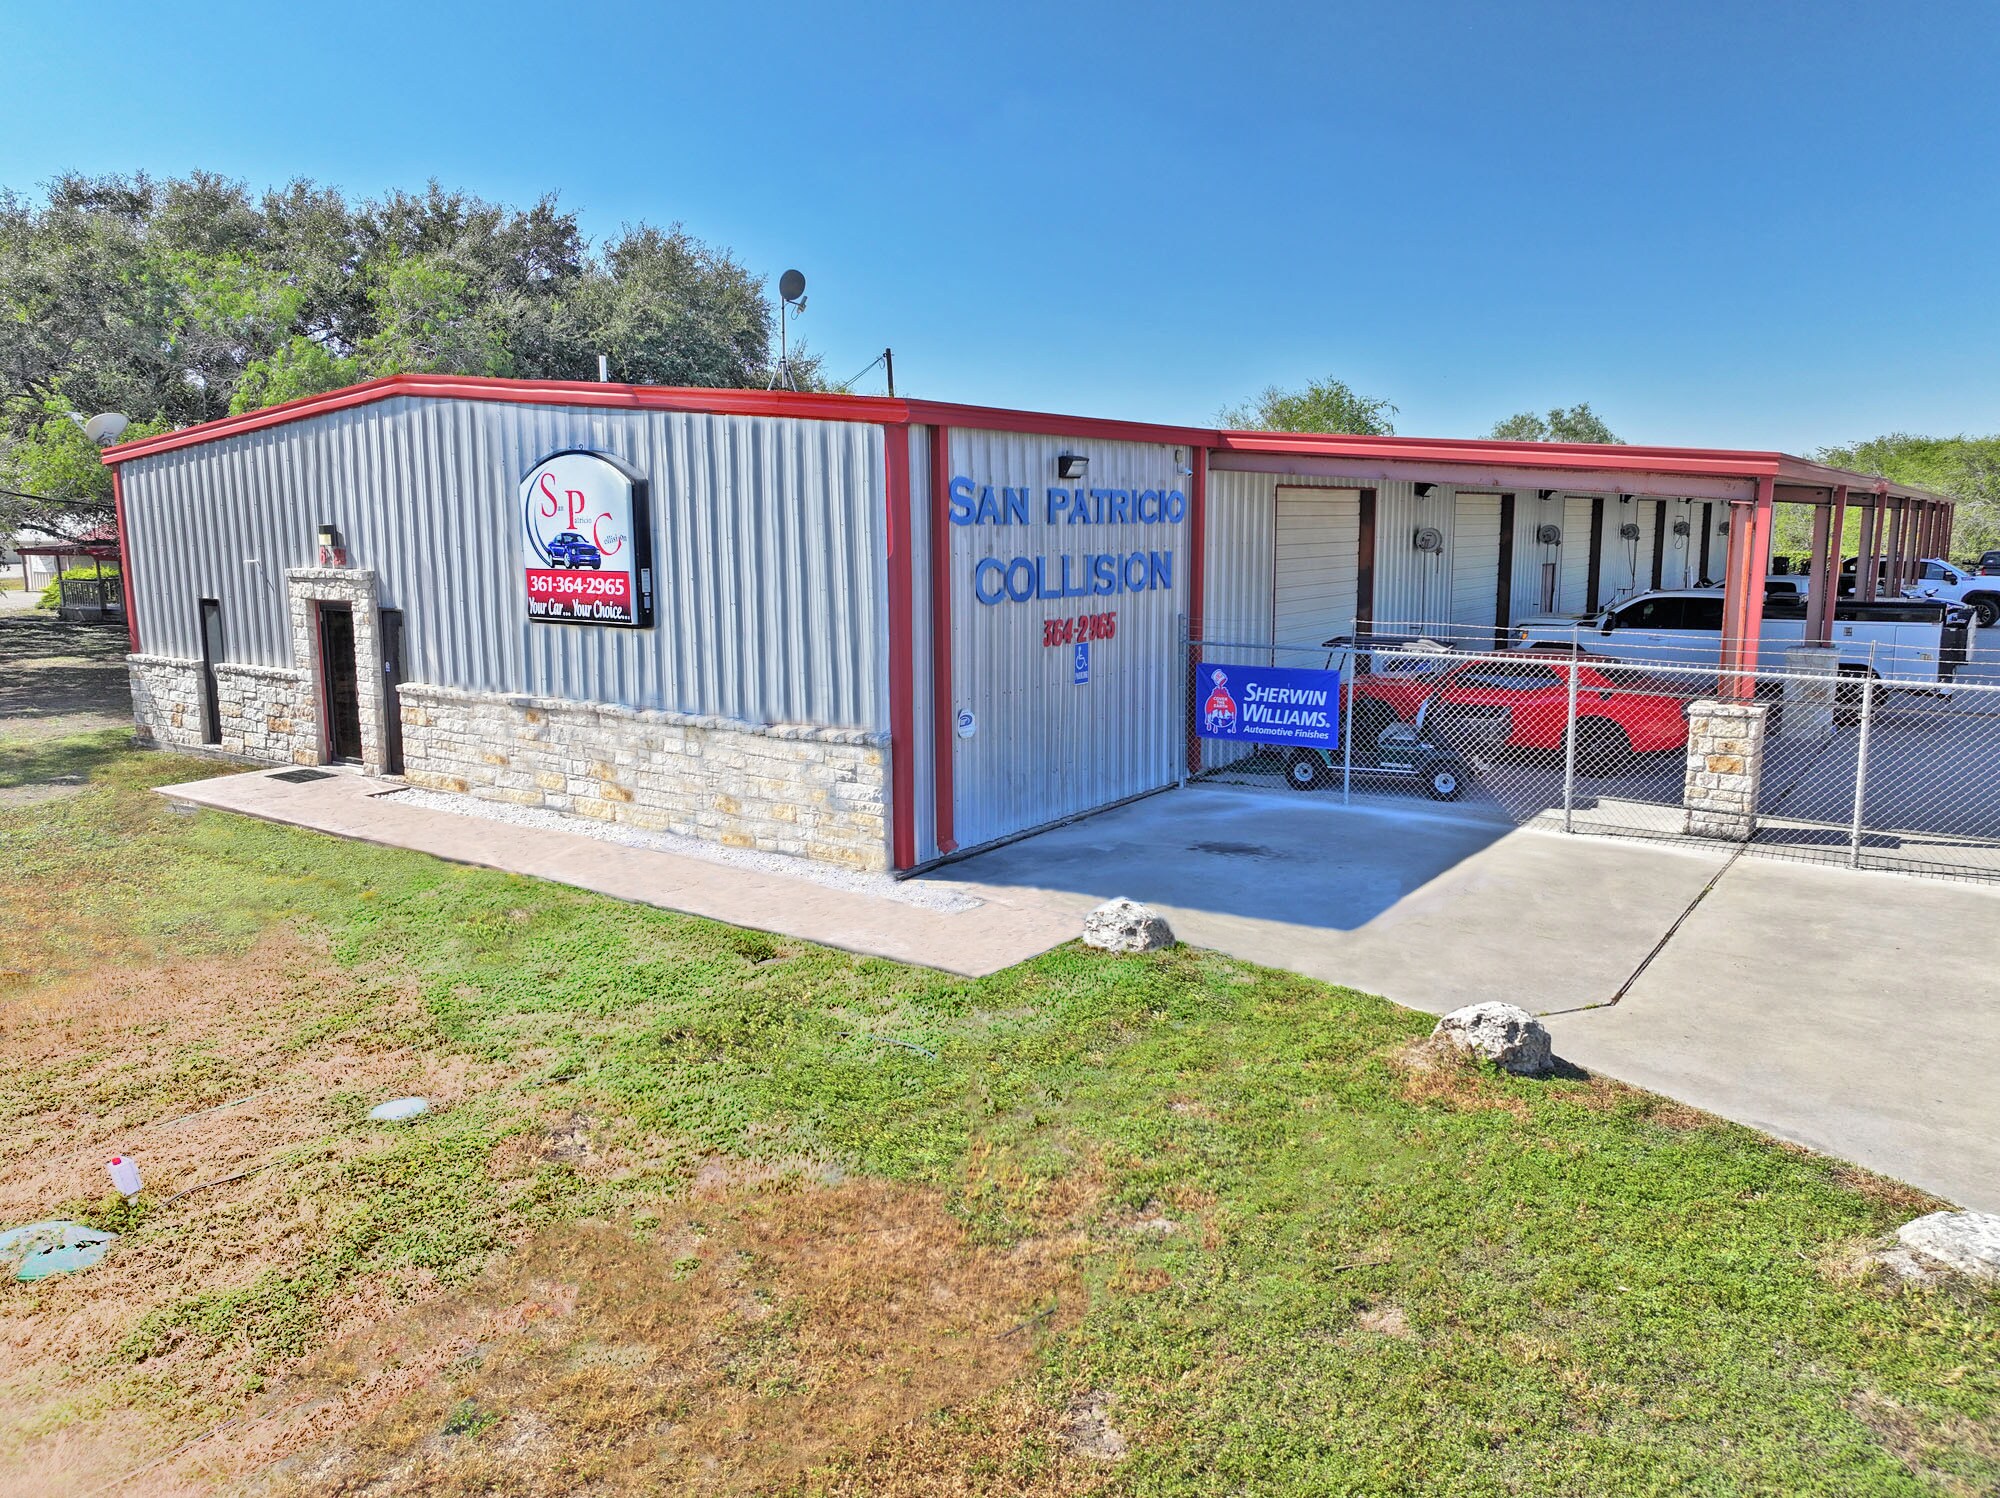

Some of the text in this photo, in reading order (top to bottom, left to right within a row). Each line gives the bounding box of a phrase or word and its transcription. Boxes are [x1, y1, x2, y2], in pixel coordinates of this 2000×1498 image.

[949, 476, 1186, 526] SAN PATRICIO
[530, 575, 625, 596] 361-364-2965
[976, 551, 1173, 606] COLLISION
[529, 597, 547, 615] Your
[548, 598, 571, 617] Car...
[572, 599, 593, 617] Your
[593, 600, 631, 620] Choice...
[1043, 612, 1117, 647] 364-2965
[1244, 683, 1328, 706] SHERWIN
[1243, 725, 1329, 740] Automotive Finishes
